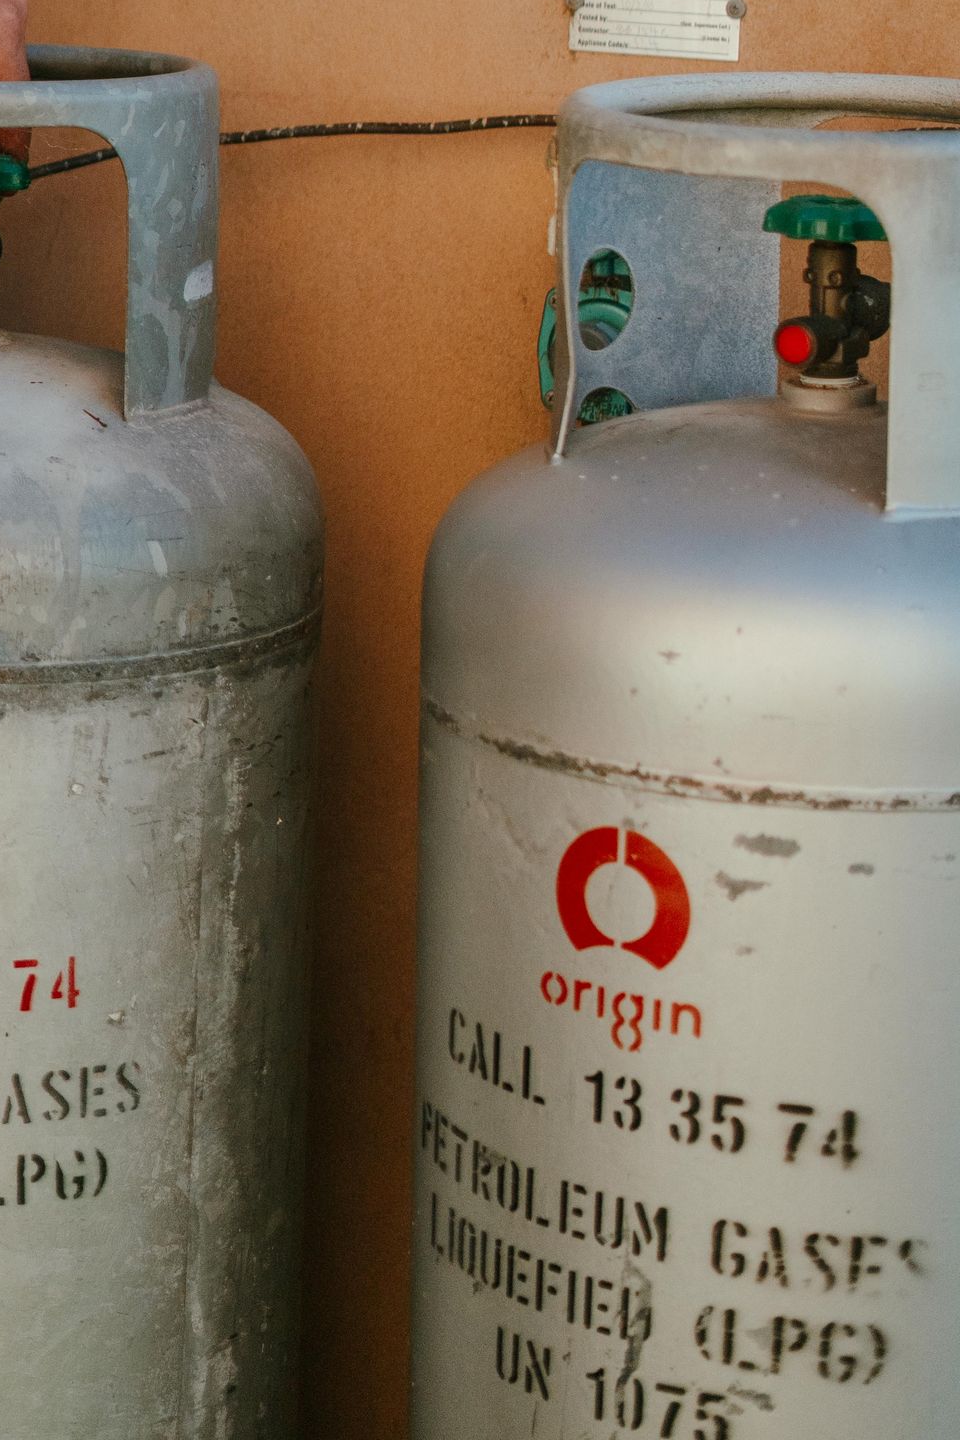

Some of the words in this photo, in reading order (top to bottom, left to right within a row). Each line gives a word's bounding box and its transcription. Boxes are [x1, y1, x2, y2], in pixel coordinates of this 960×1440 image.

[577, 39, 607, 47] Appliance
[579, 13, 598, 21] Tested
[12, 956, 81, 1013] 74
[539, 970, 703, 1053] origin
[448, 1007, 546, 1106] CALL
[583, 1069, 644, 1132] 13
[669, 1088, 746, 1154] 35
[776, 1102, 861, 1170] 74
[421, 1100, 669, 1263] PETROLEUM
[430, 1191, 653, 1342] LIQUEFIED
[694, 1304, 889, 1385] (LPG)
[495, 1325, 552, 1402] UN
[585, 1365, 730, 1440] 1075
